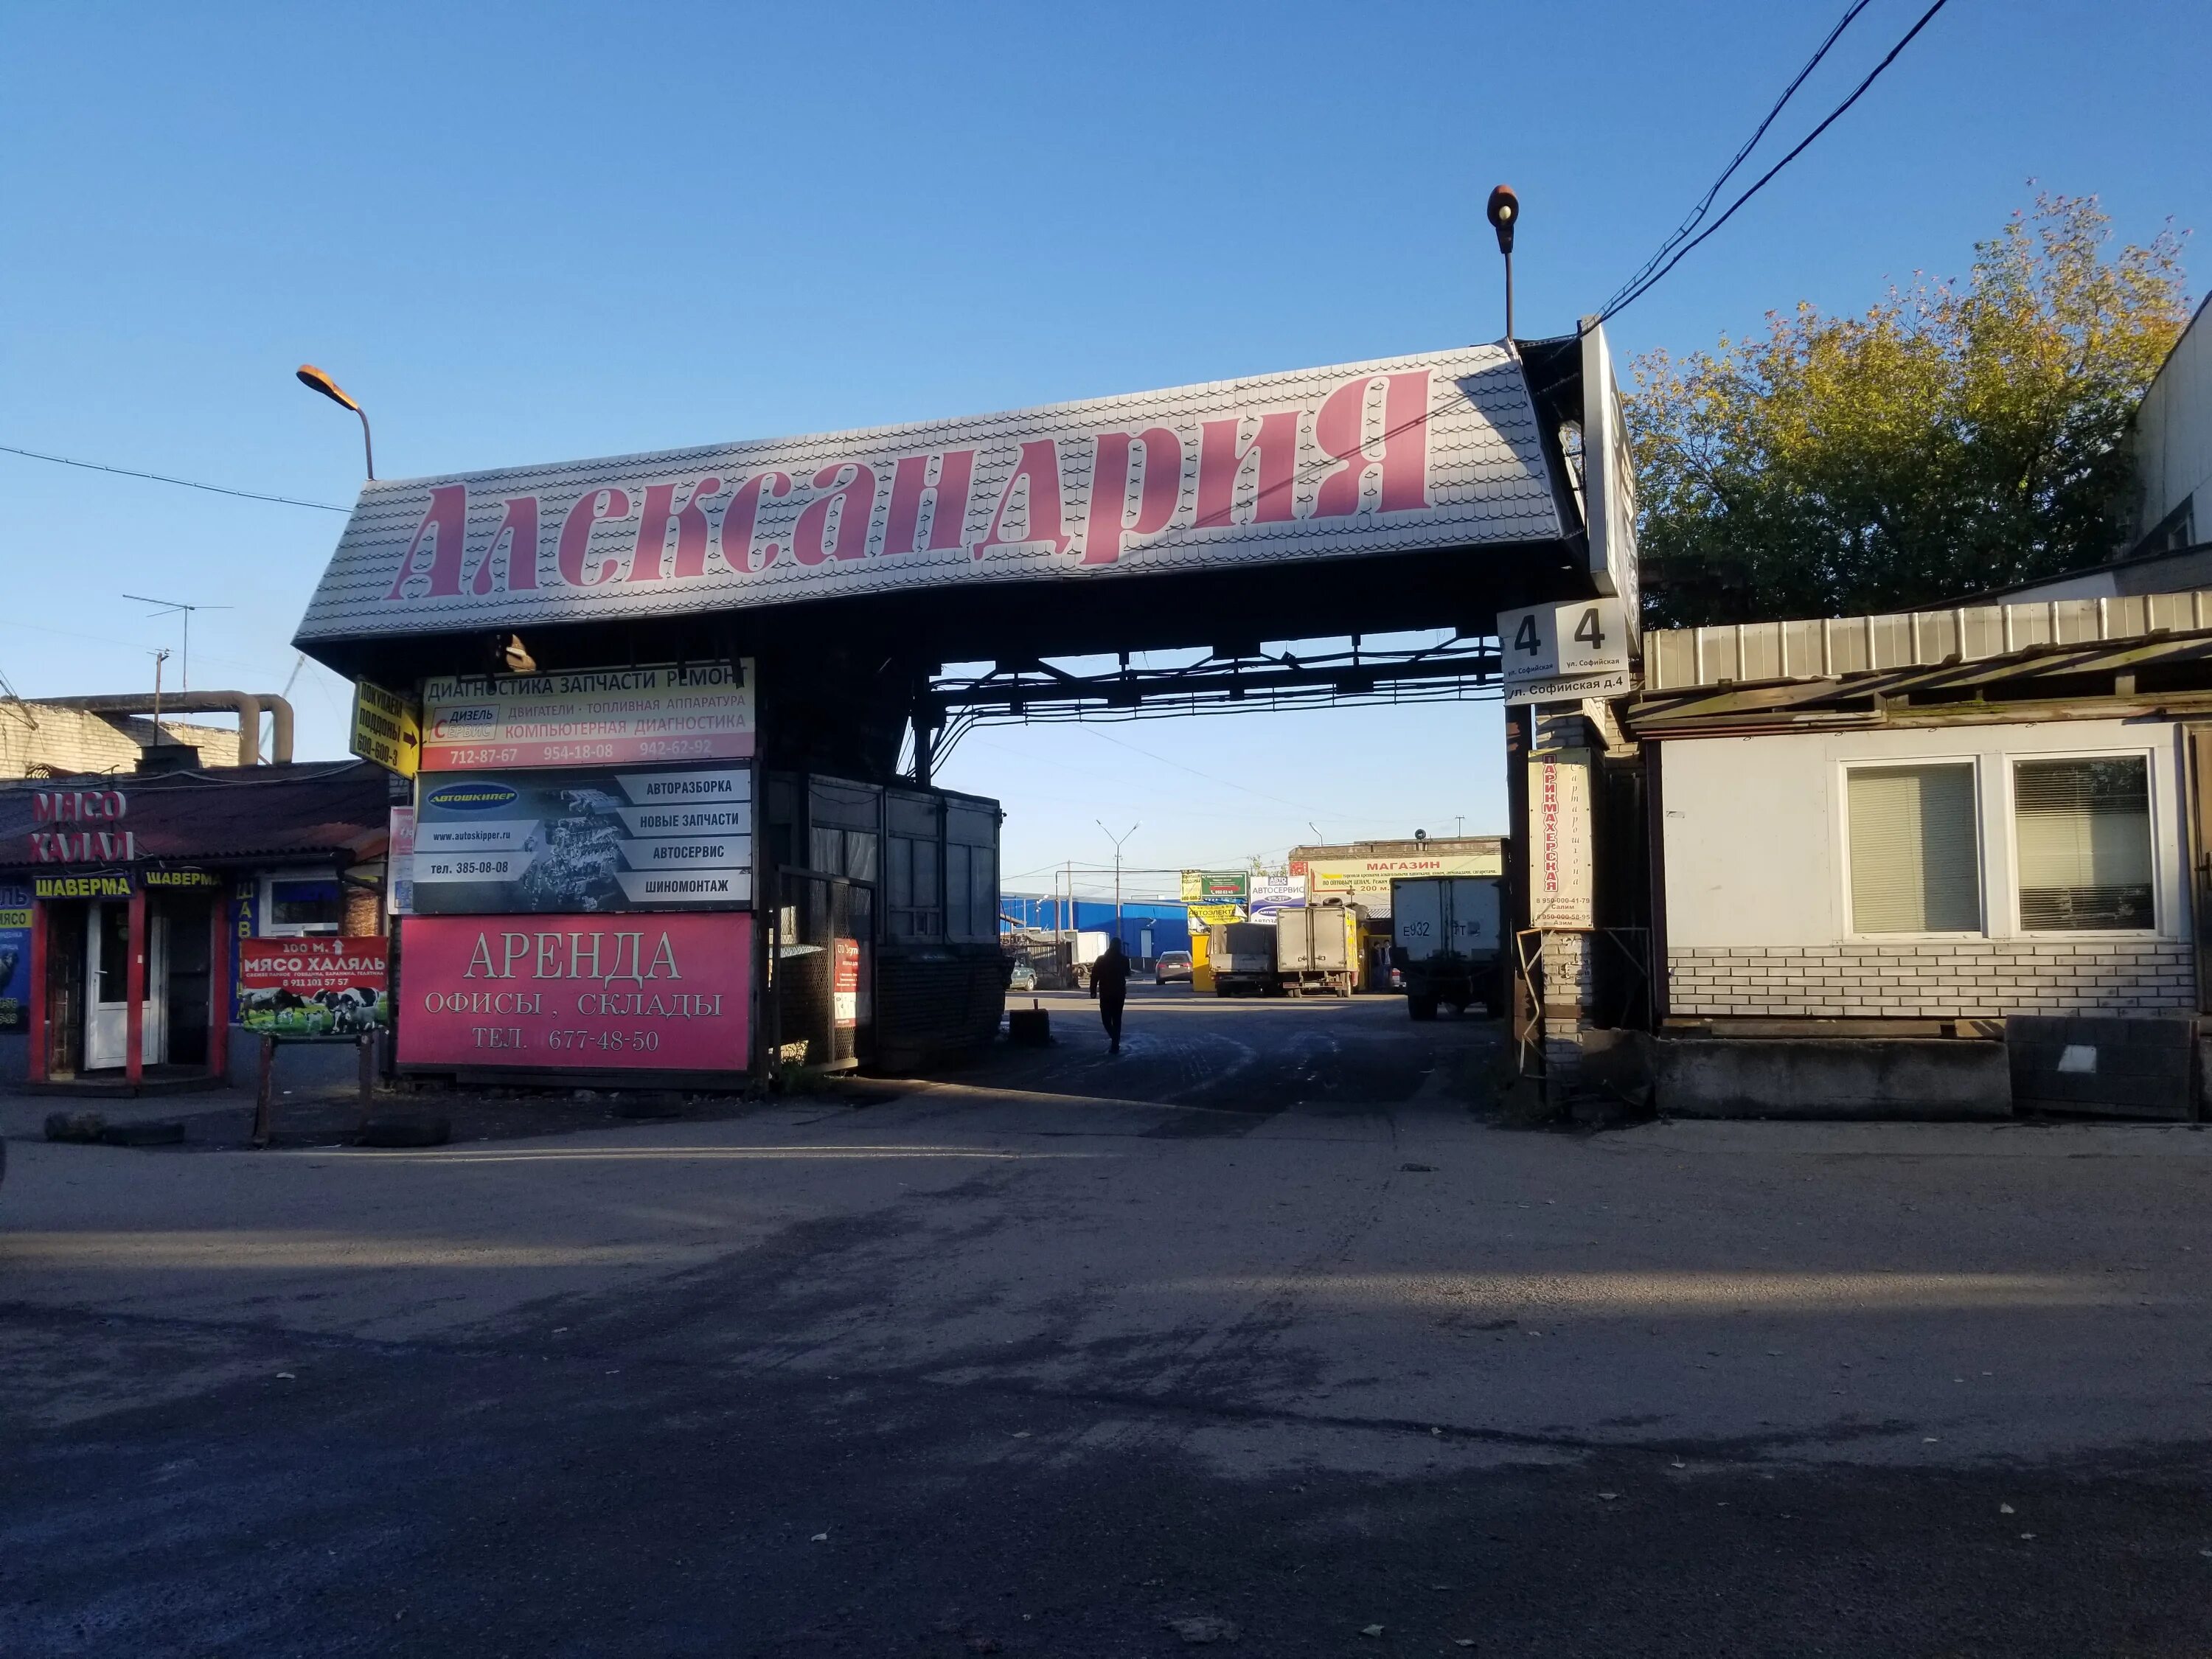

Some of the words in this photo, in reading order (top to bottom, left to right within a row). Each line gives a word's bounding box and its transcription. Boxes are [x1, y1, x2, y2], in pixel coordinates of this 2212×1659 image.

[1514, 614, 1541, 656] 4
[1574, 608, 1605, 650] 4
[1518, 664, 1553, 674] Софийская
[1579, 658, 1620, 667] Софийская
[426, 678, 554, 702] ДИАГНОСТИКА
[560, 671, 655, 695] ЗАПЧАСТИ
[667, 667, 748, 687] РЕМОН
[1529, 680, 1600, 695] Софийская
[1604, 676, 1623, 689] д.4
[361, 682, 403, 719] ПОКУПАЕМ
[508, 704, 574, 720] ДВИГАТЕЛИ
[588, 699, 660, 715] ТОПЛИВНАЯ
[667, 695, 745, 710] АППАРАТУРА
[359, 707, 401, 743] ПОДДОНЫ
[449, 709, 493, 723] ДИЗЕЛЬ
[434, 720, 491, 740] СЕРВИС
[505, 720, 627, 739] КОМПЬЮТЕРНАЯ
[634, 714, 745, 736] ДИАГНОСТИКА
[357, 733, 398, 766] 600-600-3
[451, 748, 518, 764] 712-87-67
[543, 744, 613, 761] 954-18-08
[639, 740, 712, 757] 942-62-92
[646, 779, 733, 796] АВТОРАЗБОРКА
[33, 791, 127, 821] МЯСО
[430, 791, 515, 804] АВТОШКИПЕР
[640, 814, 679, 829] НОВЫЕ
[682, 812, 740, 827] ЗАПЧАСТИ
[1542, 754, 1559, 892] ПАРИКМАХЕРСКАЯ
[433, 830, 511, 844] www.autoskipper.ru
[27, 831, 135, 863] ХАЛАЛ
[653, 845, 725, 860] АВТОСЕРВИС
[431, 863, 453, 874] тел.
[456, 861, 509, 874] 385-08-08
[1366, 861, 1440, 871] МАГАЗИН
[35, 877, 131, 897] ШАВЕРМА
[146, 872, 220, 886] ШАВЕРМА
[645, 879, 728, 894] ШИНОМОНТАЖ
[1252, 886, 1304, 894] АВТОСЕРВИС
[1403, 922, 1430, 936] Е932
[283, 943, 307, 953] 100
[313, 943, 329, 953] М.
[244, 958, 302, 973] МЯСО
[307, 957, 386, 972] ХАЛЯЛЬ
[463, 931, 682, 990] АРЕНДА
[577, 992, 723, 1020] СКЛАДЫ
[472, 1028, 527, 1050] ТЕЛ.
[549, 1030, 658, 1051] 677-48-50
